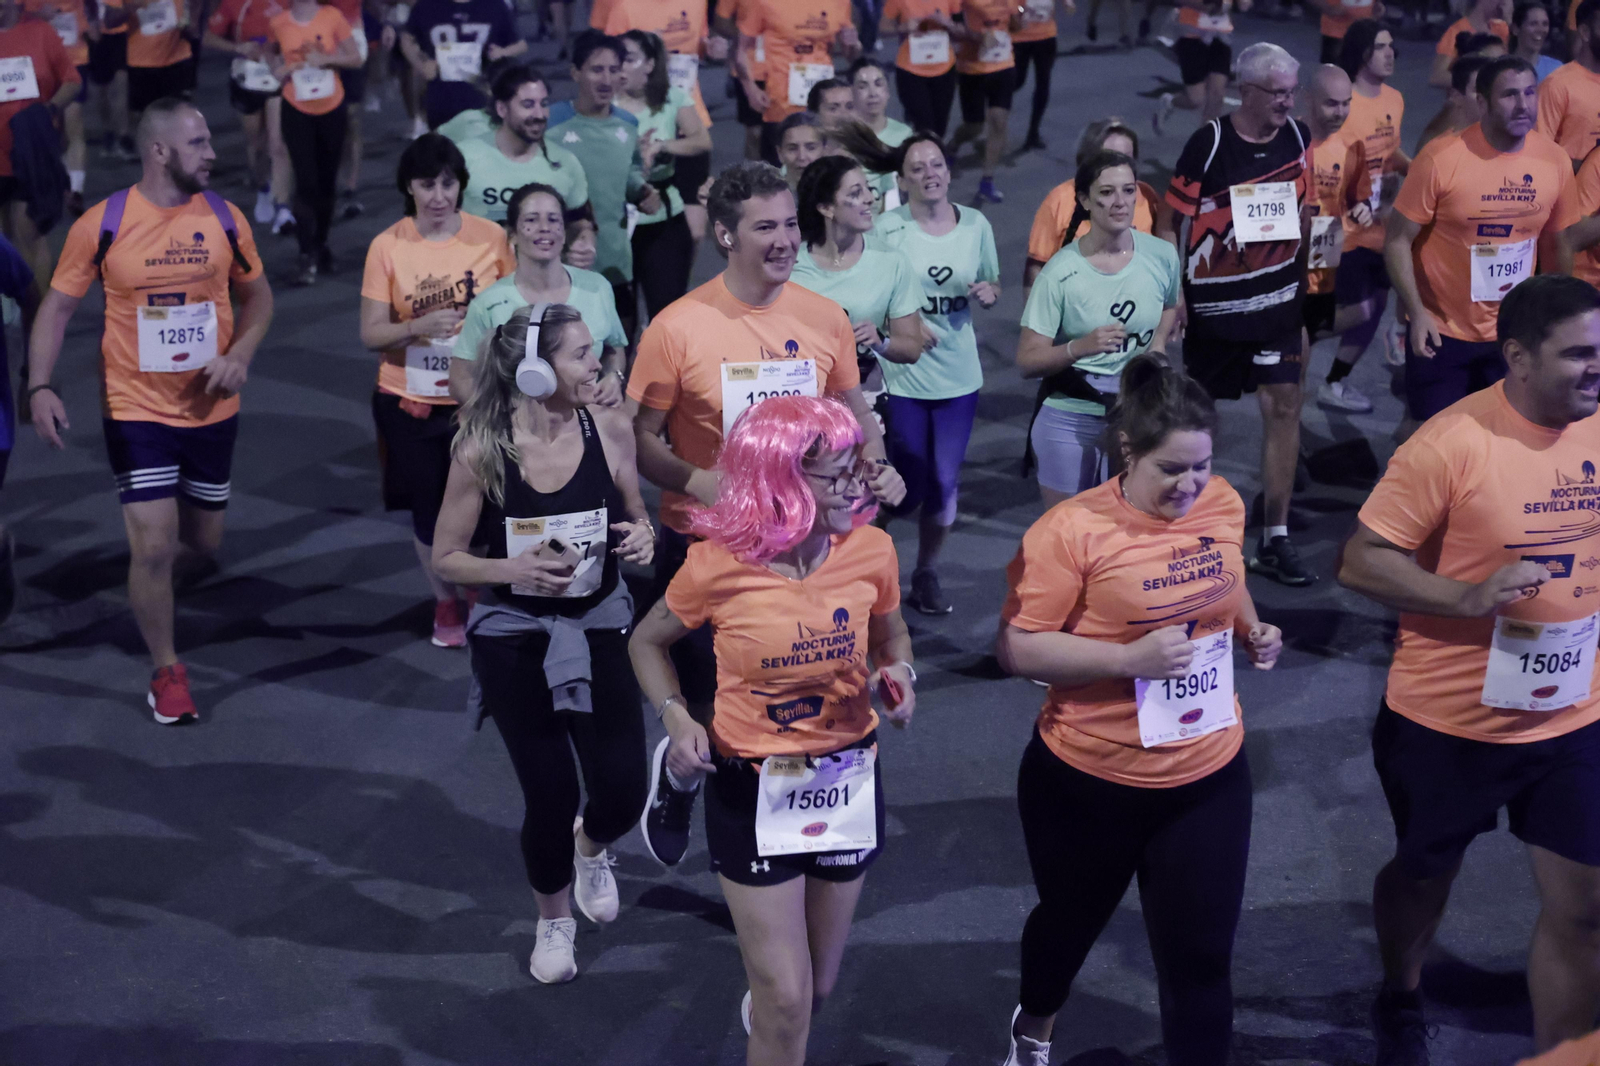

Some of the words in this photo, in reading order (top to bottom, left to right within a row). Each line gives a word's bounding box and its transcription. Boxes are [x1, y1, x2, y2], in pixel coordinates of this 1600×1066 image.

[1481, 194, 1516, 202] SEVILLA
[1516, 195, 1536, 203] KH7
[1498, 187, 1537, 195] NOCTURNA
[1247, 202, 1286, 218] 21798
[165, 248, 210, 256] NOCTURNA
[145, 257, 186, 267] SEVILLA
[1488, 259, 1523, 277] 17981
[158, 326, 205, 344] 12875
[423, 357, 452, 371] 128
[583, 421, 590, 430] DO
[1551, 485, 1600, 498] NOCTURNA
[1524, 500, 1576, 514] SEVILLA
[1168, 550, 1223, 573] NOCTURNA
[1143, 571, 1196, 591] SEVILLA
[1198, 561, 1223, 579] KH7
[792, 631, 856, 652] NOCTURNA
[761, 652, 823, 669] SEVILLA
[826, 642, 855, 660] KH7
[1520, 648, 1582, 674] 15084
[1162, 667, 1218, 700] 15902
[786, 783, 849, 810] 15601
[804, 825, 824, 834] KH7
